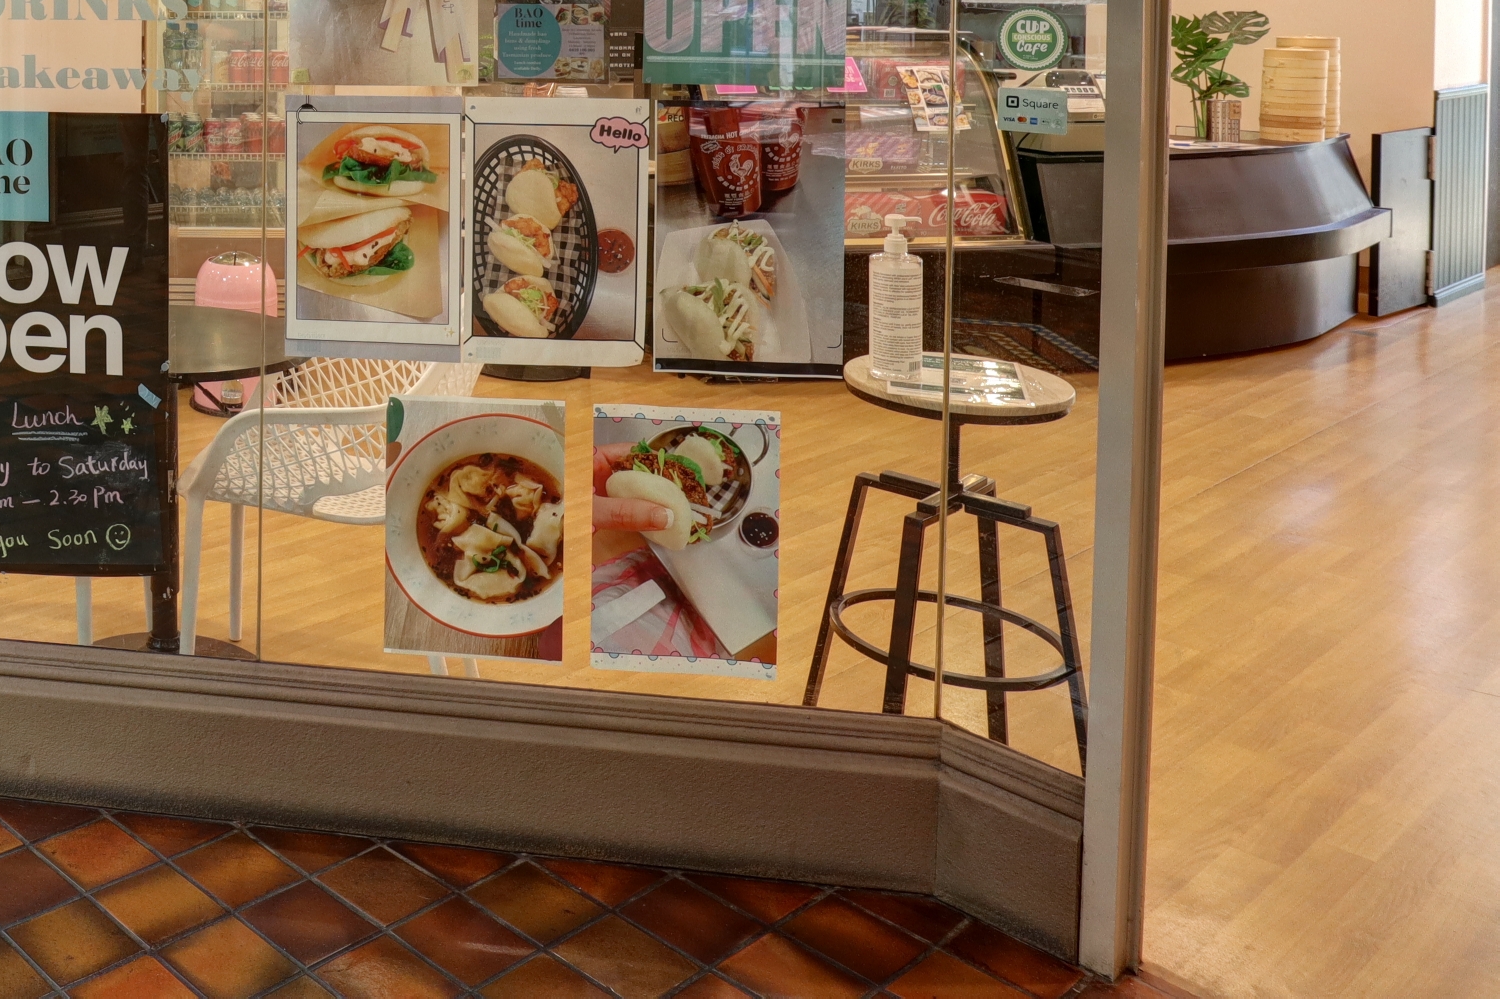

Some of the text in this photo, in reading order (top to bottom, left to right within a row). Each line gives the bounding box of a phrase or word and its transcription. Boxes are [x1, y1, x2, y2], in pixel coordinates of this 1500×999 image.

[514, 7, 544, 19] BAO
[515, 19, 543, 28] time
[1015, 19, 1051, 34] CUP
[1013, 33, 1051, 41] CONSCIOUS
[1016, 40, 1048, 55] Cafe
[1022, 98, 1059, 110] Square
[667, 114, 685, 123] REC
[599, 124, 642, 142] Hello
[725, 130, 738, 139] HOT
[852, 158, 882, 169] KIRKS
[851, 220, 880, 231] KIRKS
[11, 404, 83, 430] Lunch
[27, 456, 52, 476] to
[57, 450, 150, 481] Saturday
